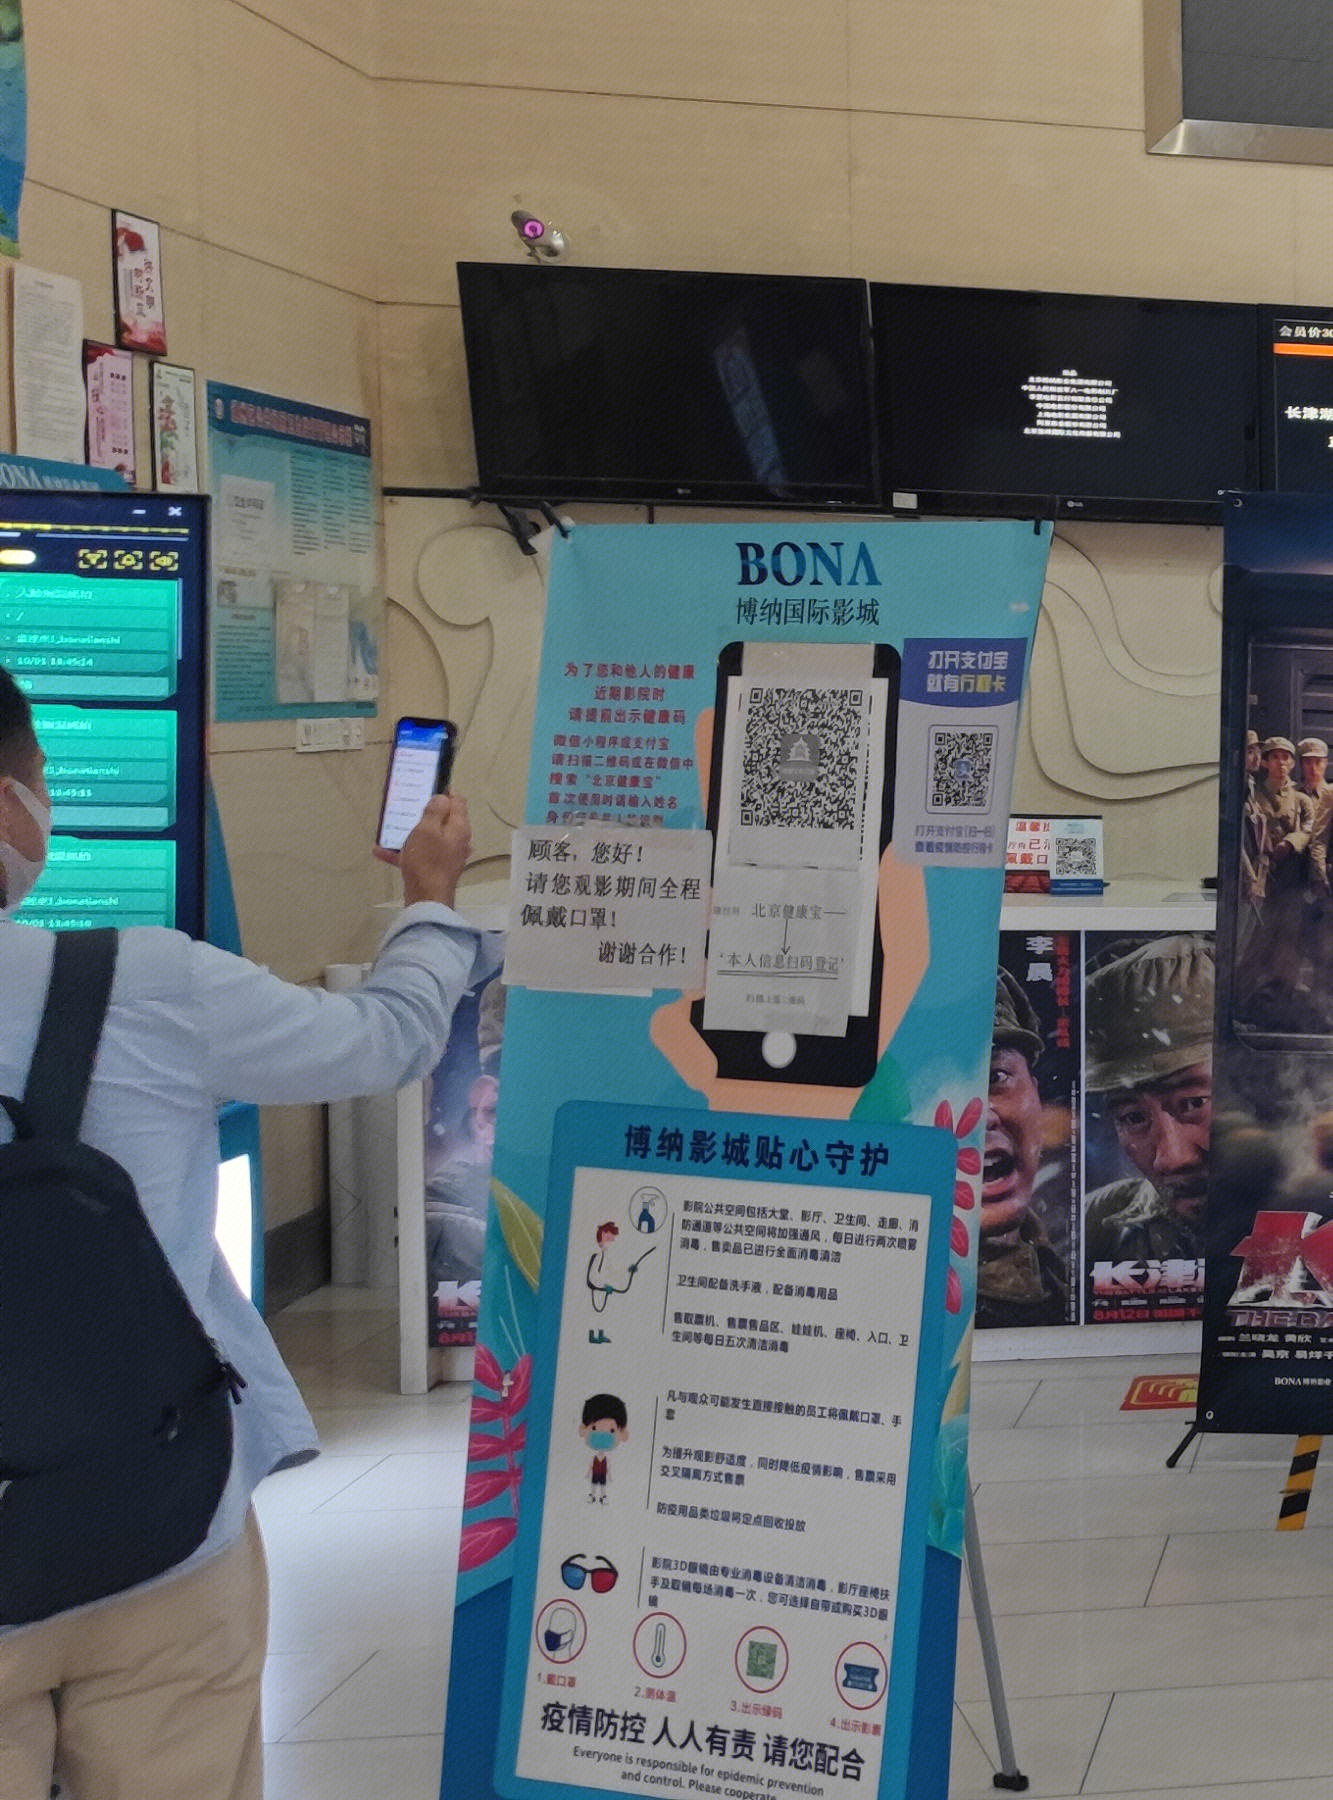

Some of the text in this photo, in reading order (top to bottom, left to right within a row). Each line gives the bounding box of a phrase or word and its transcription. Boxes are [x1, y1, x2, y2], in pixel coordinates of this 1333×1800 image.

[0, 461, 43, 488] ONA
[735, 542, 882, 587] BONA
[736, 598, 880, 627] 博纳国际影城
[564, 662, 695, 679] 为了您和他人的健康
[928, 650, 1008, 670] 打开支付宝
[554, 734, 669, 750] 微信小程序或支付宝
[524, 872, 702, 901] 请您观影期间全程
[752, 903, 822, 920] 北京健康宝
[624, 1125, 890, 1178] 博纳影城贴心守护
[660, 1464, 745, 1486] 交叉隔离方式售票
[540, 1701, 866, 1782] 疫情防控 人人有责 请您配合
[574, 1745, 824, 1797] Everyone is responsible for epidemic prevention
[621, 1770, 641, 1782] and
[644, 1772, 685, 1790] control.
[689, 1778, 722, 1794] Please
